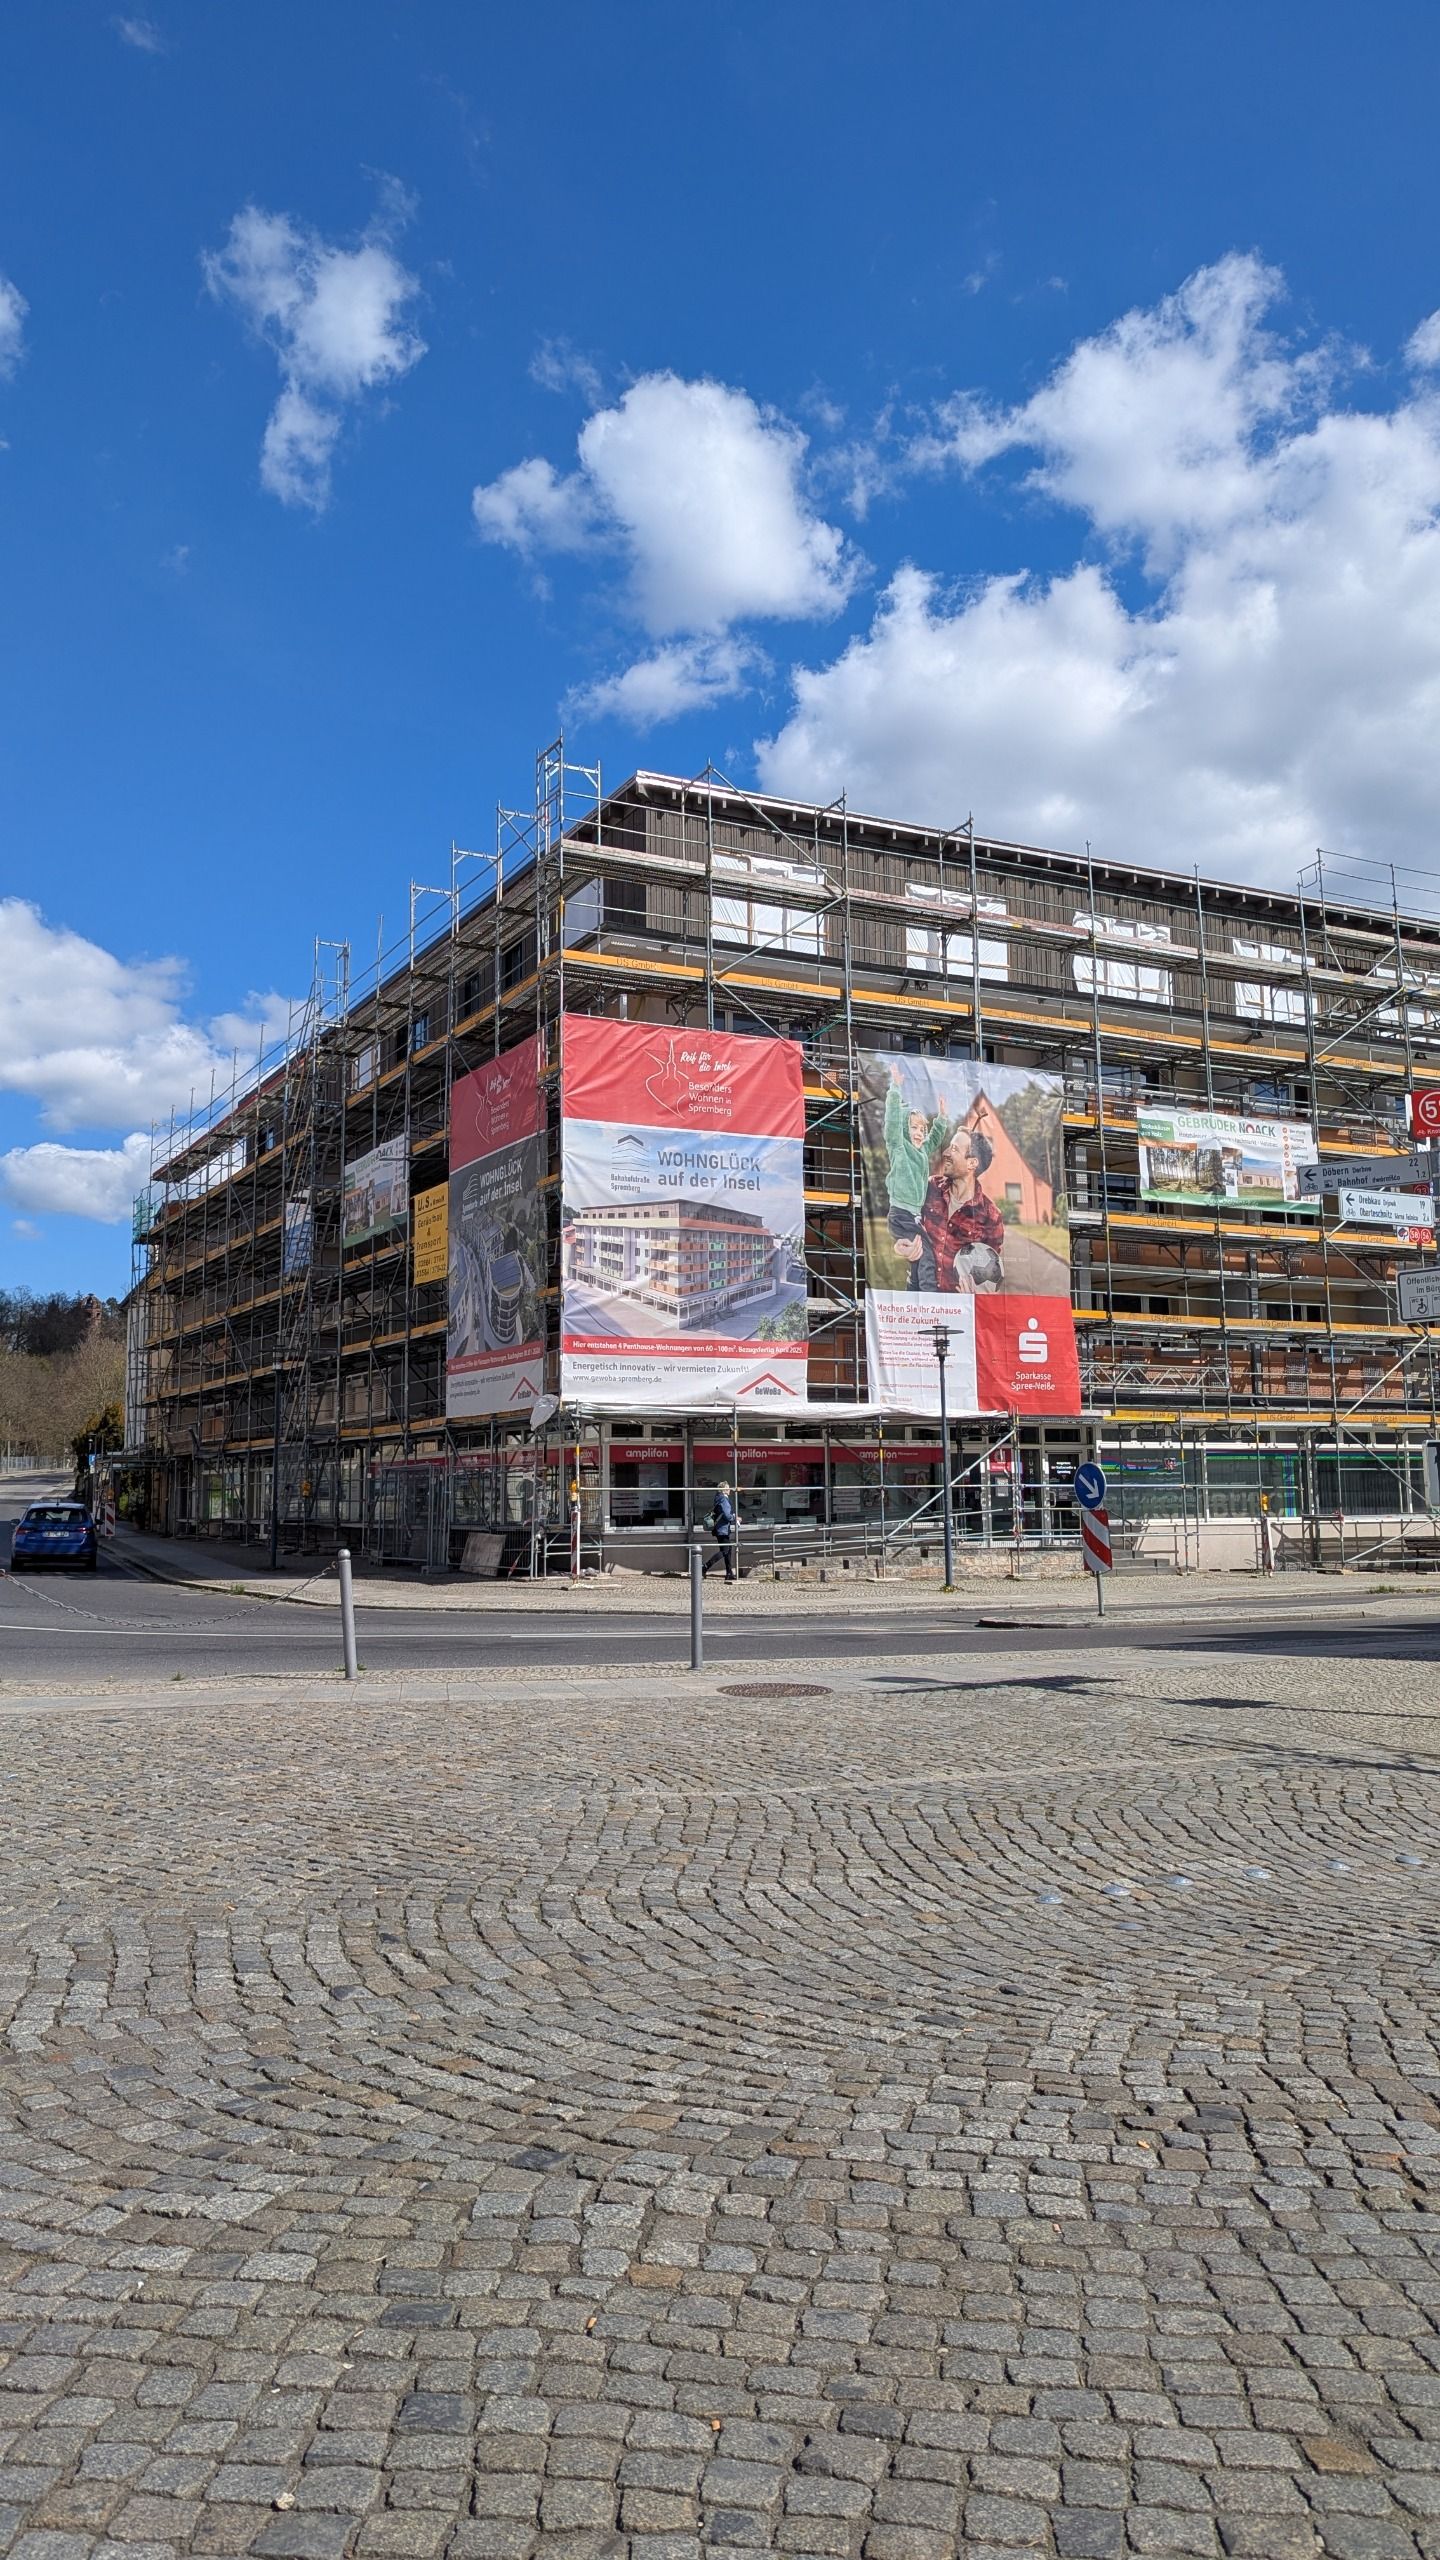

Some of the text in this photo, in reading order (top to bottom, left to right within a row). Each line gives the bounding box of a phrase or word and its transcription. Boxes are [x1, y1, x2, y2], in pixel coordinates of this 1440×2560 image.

[680, 1051, 712, 1065] Reif für
[699, 1061, 732, 1072] die Insel
[688, 1081, 732, 1094] Besonders
[688, 1092, 724, 1104] Wohnen
[688, 1104, 732, 1116] Spremberg
[1425, 1100, 1440, 1118] 5
[1178, 1115, 1276, 1138] GEBRÜDER NOACK
[657, 1150, 761, 1172] WOHNGLÜCK
[480, 1156, 522, 1188] WOHNGLÜCK
[1322, 1168, 1349, 1177] Döbern
[1408, 1158, 1418, 1167] 22
[610, 1174, 650, 1184] Bahnhofstraße
[658, 1174, 761, 1192] auf der Insel
[1338, 1176, 1368, 1188] Bahnhof
[480, 1175, 522, 1206] auf der Insel
[610, 1183, 641, 1194] Spremberg
[1358, 1194, 1380, 1206] Drebkau
[1360, 1207, 1392, 1219] Oberteschnitz
[1410, 1231, 1430, 1241] 58 56
[416, 1236, 442, 1250] Transport
[1416, 1286, 1424, 1294] im
[877, 1304, 962, 1314] Machen Sie Ihr Zuhause
[886, 1316, 896, 1324] für
[898, 1316, 910, 1324] die
[911, 1316, 942, 1326] Zukunft.
[572, 1340, 587, 1348] Hier
[587, 1342, 617, 1350] entstehen
[623, 1342, 692, 1353] Penthouse-Wohnungen
[706, 1344, 713, 1352] 60
[572, 1362, 618, 1372] Energetisch
[619, 1362, 655, 1372] innovativ
[664, 1364, 676, 1372] wir
[677, 1365, 716, 1373] vermieten
[718, 1365, 750, 1374] Zukunft!
[572, 1375, 662, 1384] www.gewoba-spremberg.de
[1016, 1372, 1052, 1381] Sparkasse
[755, 1386, 782, 1396] GeWoBa
[1011, 1382, 1056, 1391] Spree-Neiße
[626, 1448, 668, 1460] amplifon
[726, 1449, 767, 1460] amplifon
